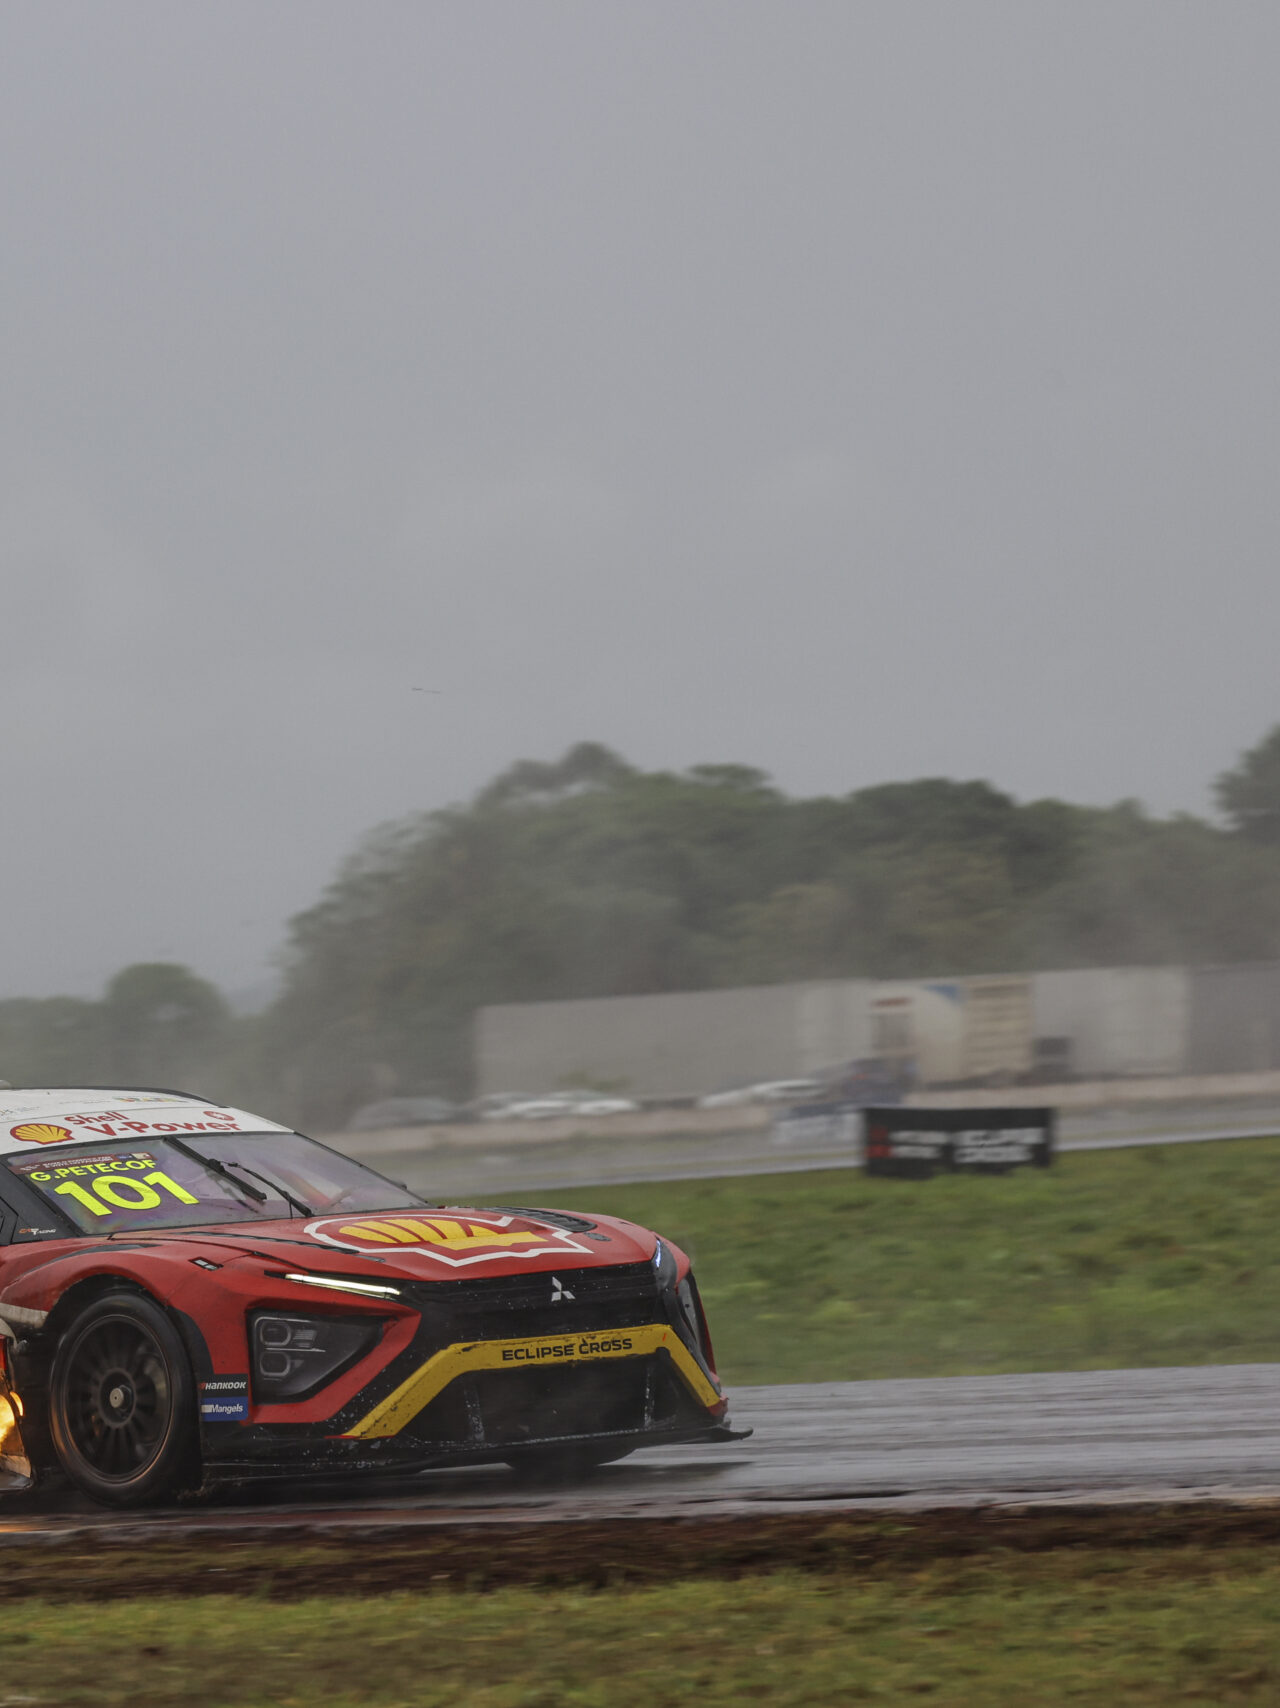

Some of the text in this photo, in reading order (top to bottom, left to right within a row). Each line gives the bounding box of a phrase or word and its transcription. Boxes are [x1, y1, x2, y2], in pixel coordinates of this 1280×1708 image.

[64, 1111, 129, 1125] Shell
[82, 1121, 242, 1136] V-Power
[30, 1159, 156, 1182] G.PETECOF
[54, 1171, 200, 1216] 101
[502, 1338, 633, 1361] ECLIPSE CROSS
[212, 1404, 244, 1415] Mangels
